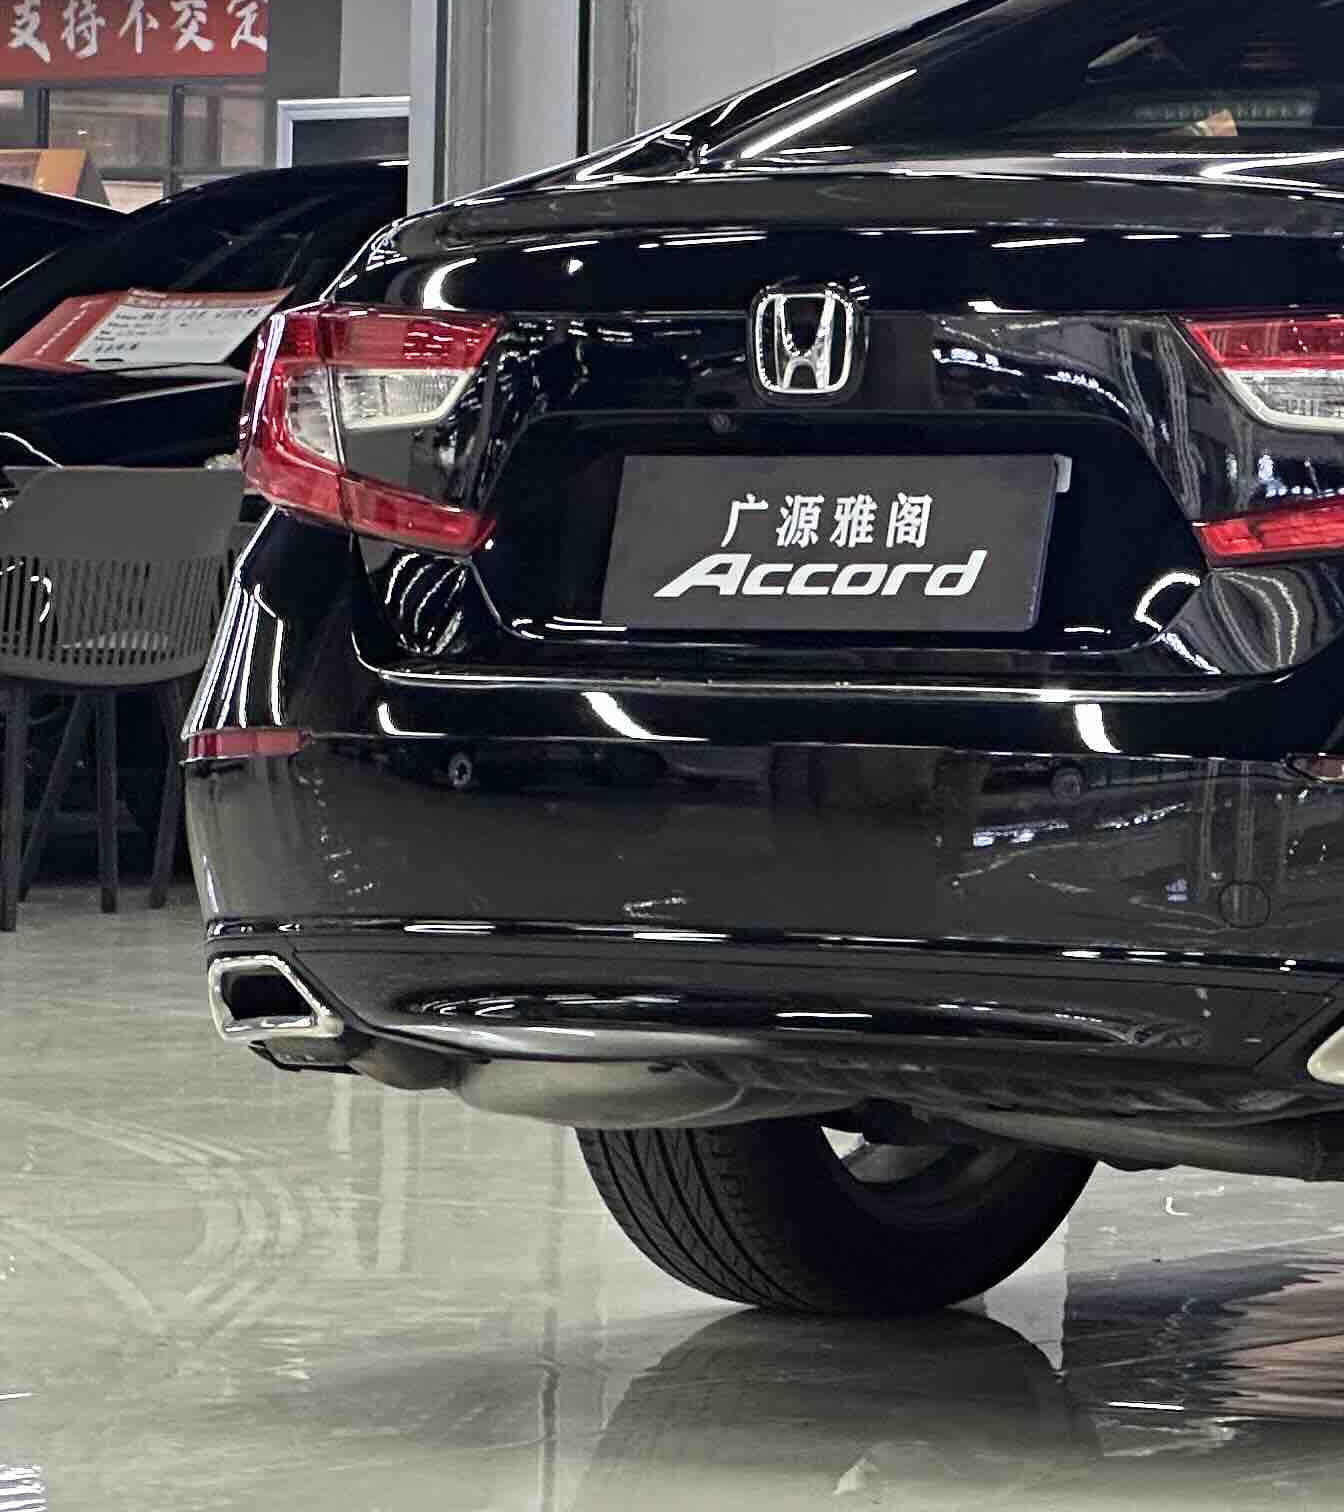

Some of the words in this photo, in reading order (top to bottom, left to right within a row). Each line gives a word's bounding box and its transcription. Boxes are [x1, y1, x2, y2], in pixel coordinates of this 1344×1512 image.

[721, 493, 933, 548] 广源雅阁
[653, 549, 988, 598] Accord
